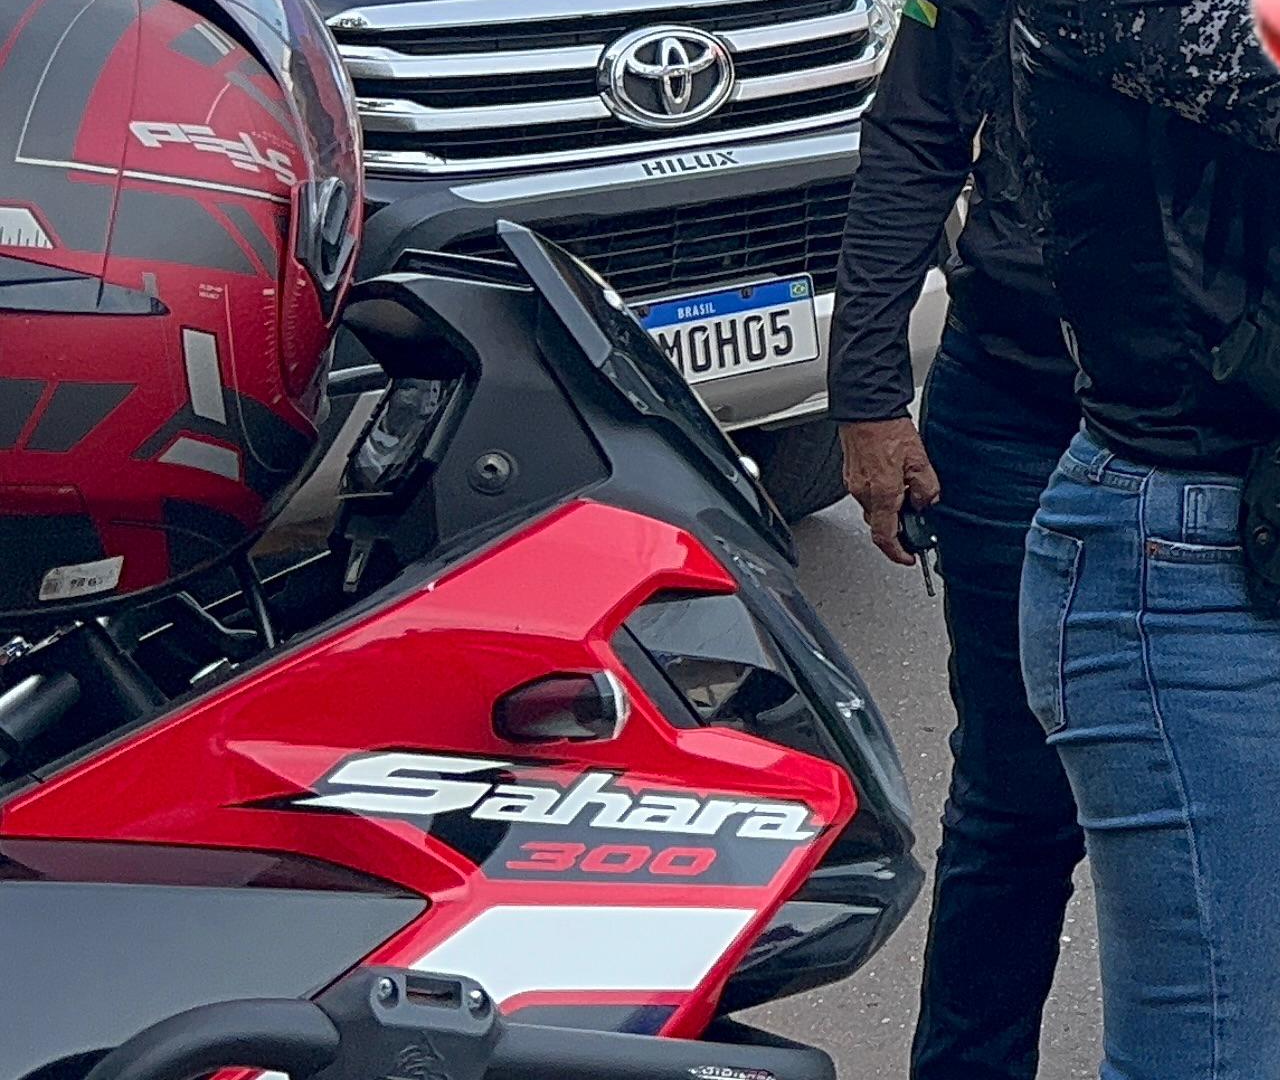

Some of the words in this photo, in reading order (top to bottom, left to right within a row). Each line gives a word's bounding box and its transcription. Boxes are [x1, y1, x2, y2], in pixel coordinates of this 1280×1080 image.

[642, 151, 739, 176] HILUX
[677, 302, 717, 319] BRASIL
[297, 753, 824, 840] Sahara
[505, 842, 717, 875] 300
